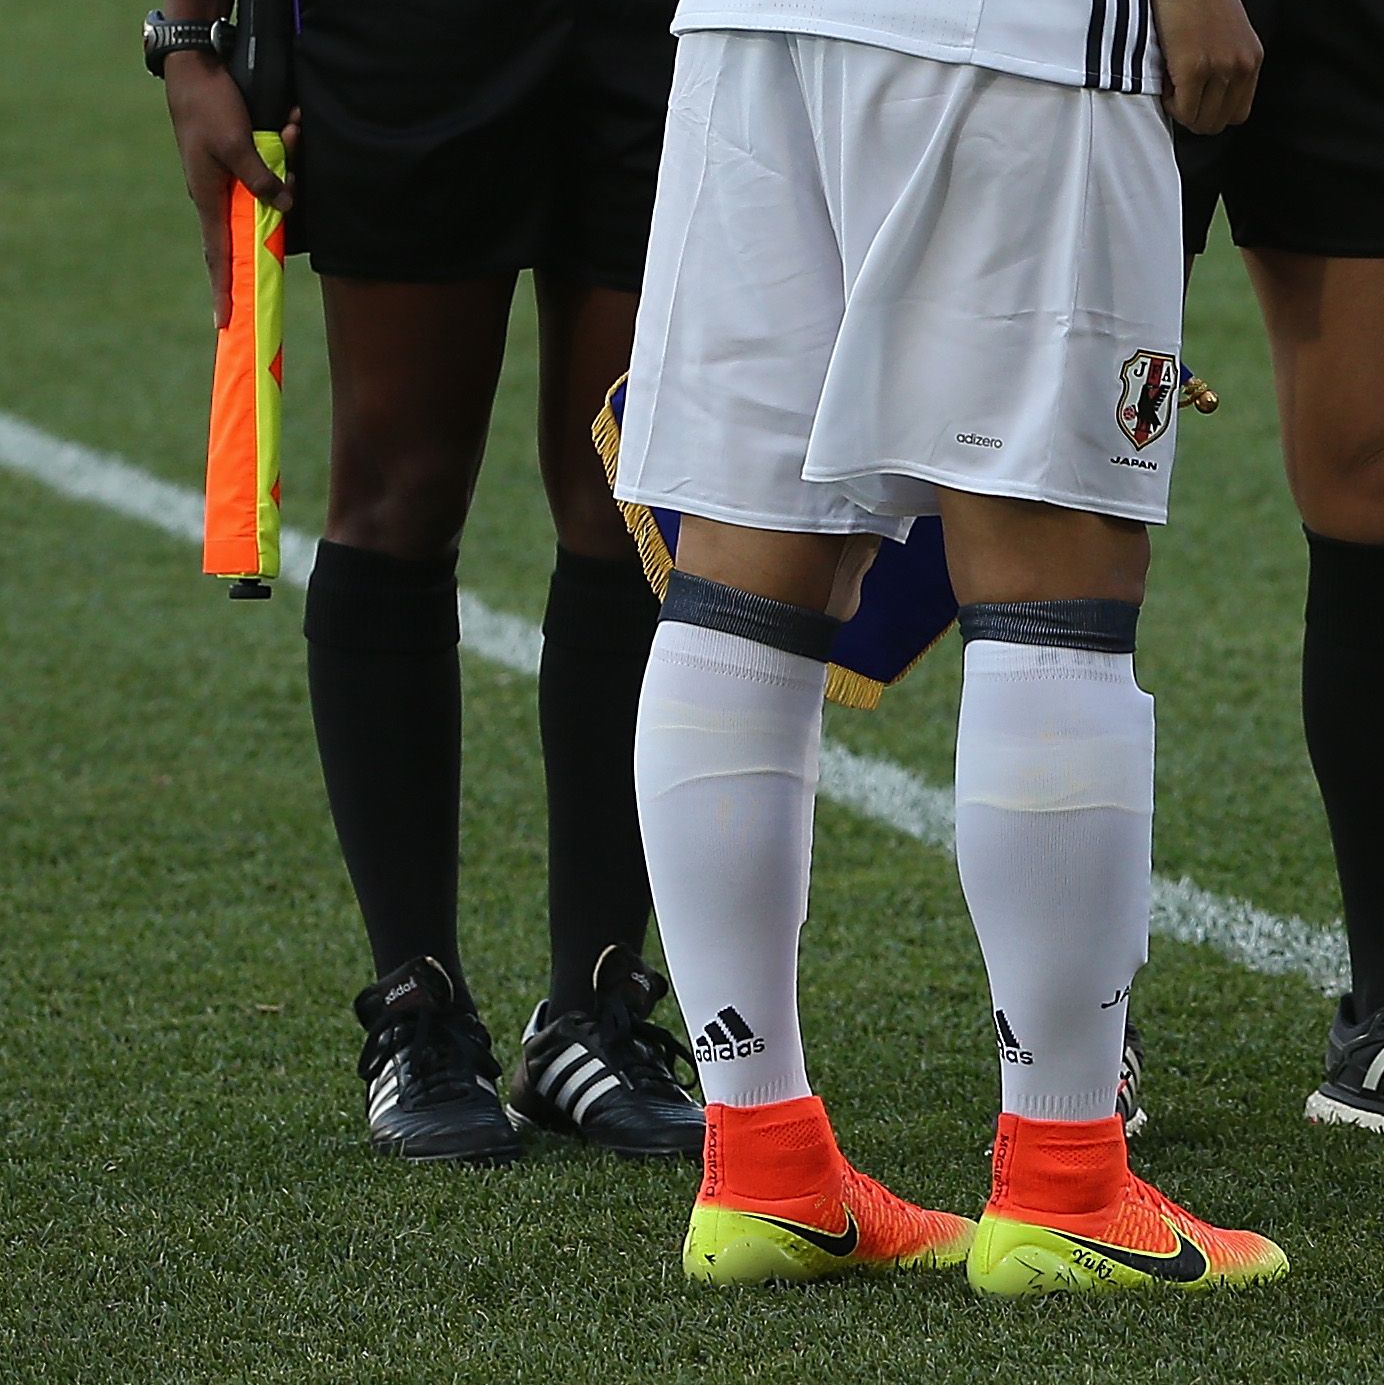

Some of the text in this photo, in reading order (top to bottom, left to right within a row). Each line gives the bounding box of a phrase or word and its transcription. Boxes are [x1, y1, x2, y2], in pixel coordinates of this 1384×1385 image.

[956, 433, 1003, 449] adizero
[1110, 456, 1158, 470] JAPAN
[695, 1038, 766, 1063] adidas
